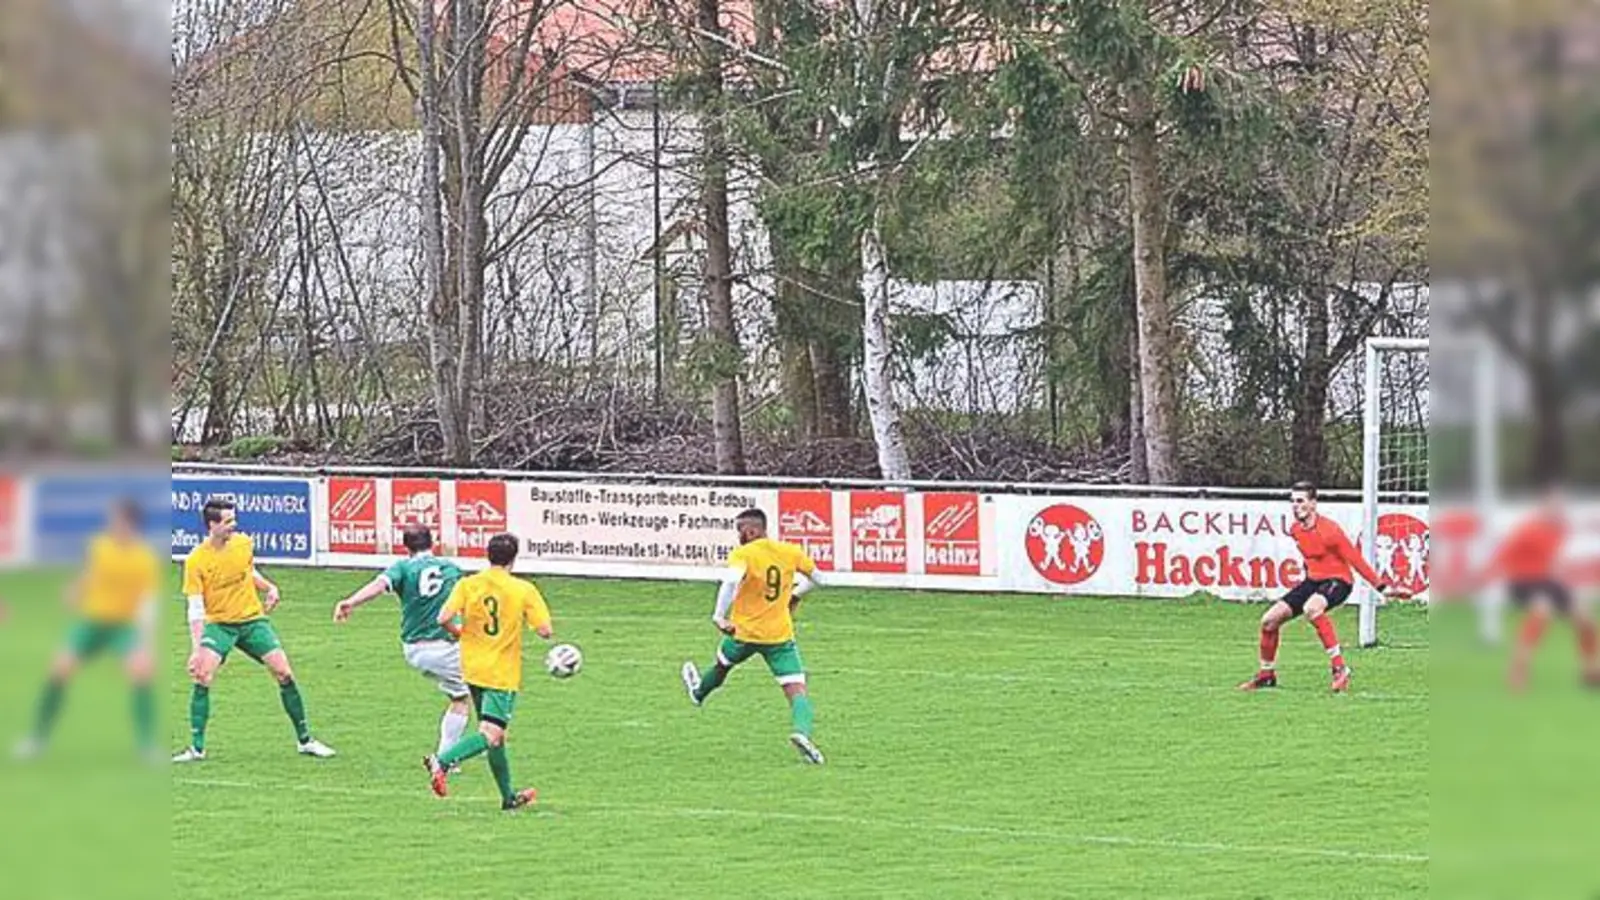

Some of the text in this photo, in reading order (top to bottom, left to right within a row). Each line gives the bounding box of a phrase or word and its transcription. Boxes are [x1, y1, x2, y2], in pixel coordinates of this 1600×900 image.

[708, 491, 757, 509] Erdbau
[543, 509, 588, 526] Fliesen
[598, 511, 669, 532] Werkzeuge
[678, 513, 735, 530] Fachmar
[1131, 510, 1292, 536] BACKHAU
[330, 523, 376, 546] heinz
[527, 538, 575, 557] Ingolstadt
[853, 539, 906, 564] heinz
[925, 542, 980, 567] heinz
[1134, 541, 1301, 590] Hackne
[418, 567, 444, 598] 6
[765, 565, 781, 602] 9
[483, 596, 499, 637] 3
